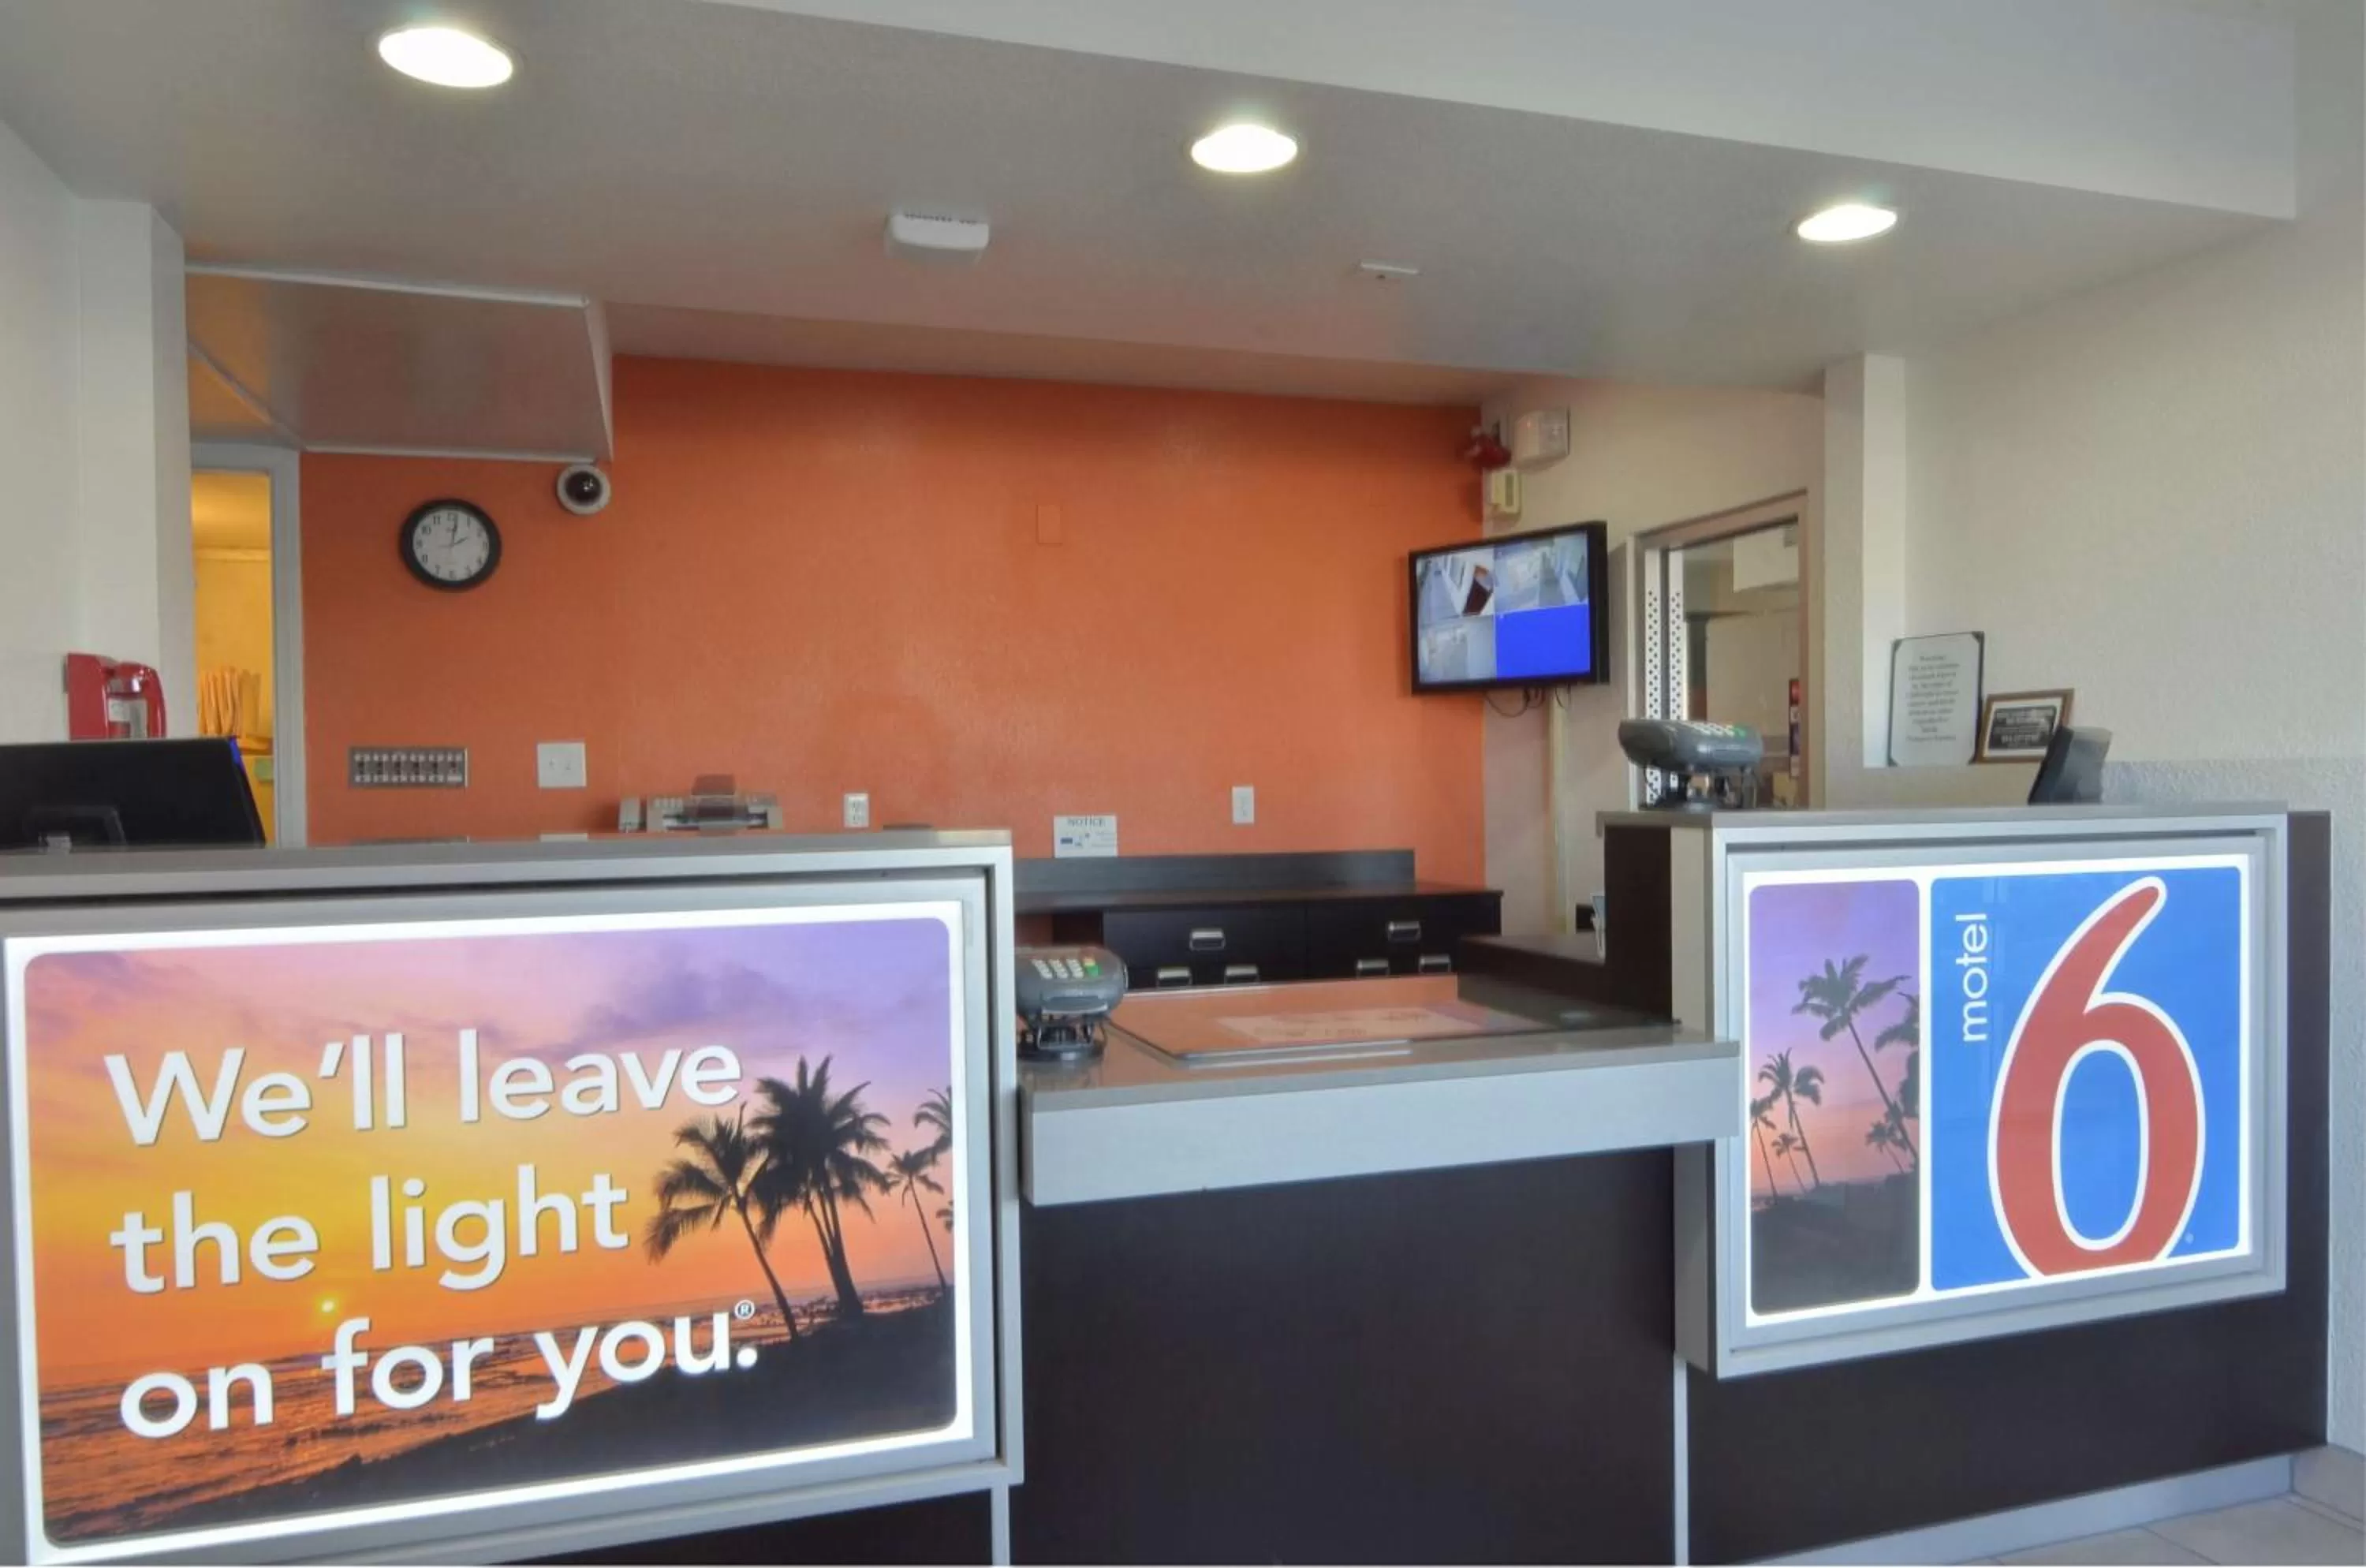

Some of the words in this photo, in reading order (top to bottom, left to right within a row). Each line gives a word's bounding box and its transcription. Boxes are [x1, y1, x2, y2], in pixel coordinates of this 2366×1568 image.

[1067, 817, 1105, 827] NOTICE
[1955, 913, 1989, 1043] motel
[104, 1032, 408, 1146] We'll
[458, 1028, 742, 1123] leave
[1987, 875, 2206, 1279] 6
[110, 1189, 319, 1294] the
[369, 1163, 629, 1290] light
[119, 1361, 275, 1439] on
[321, 1316, 495, 1417] for
